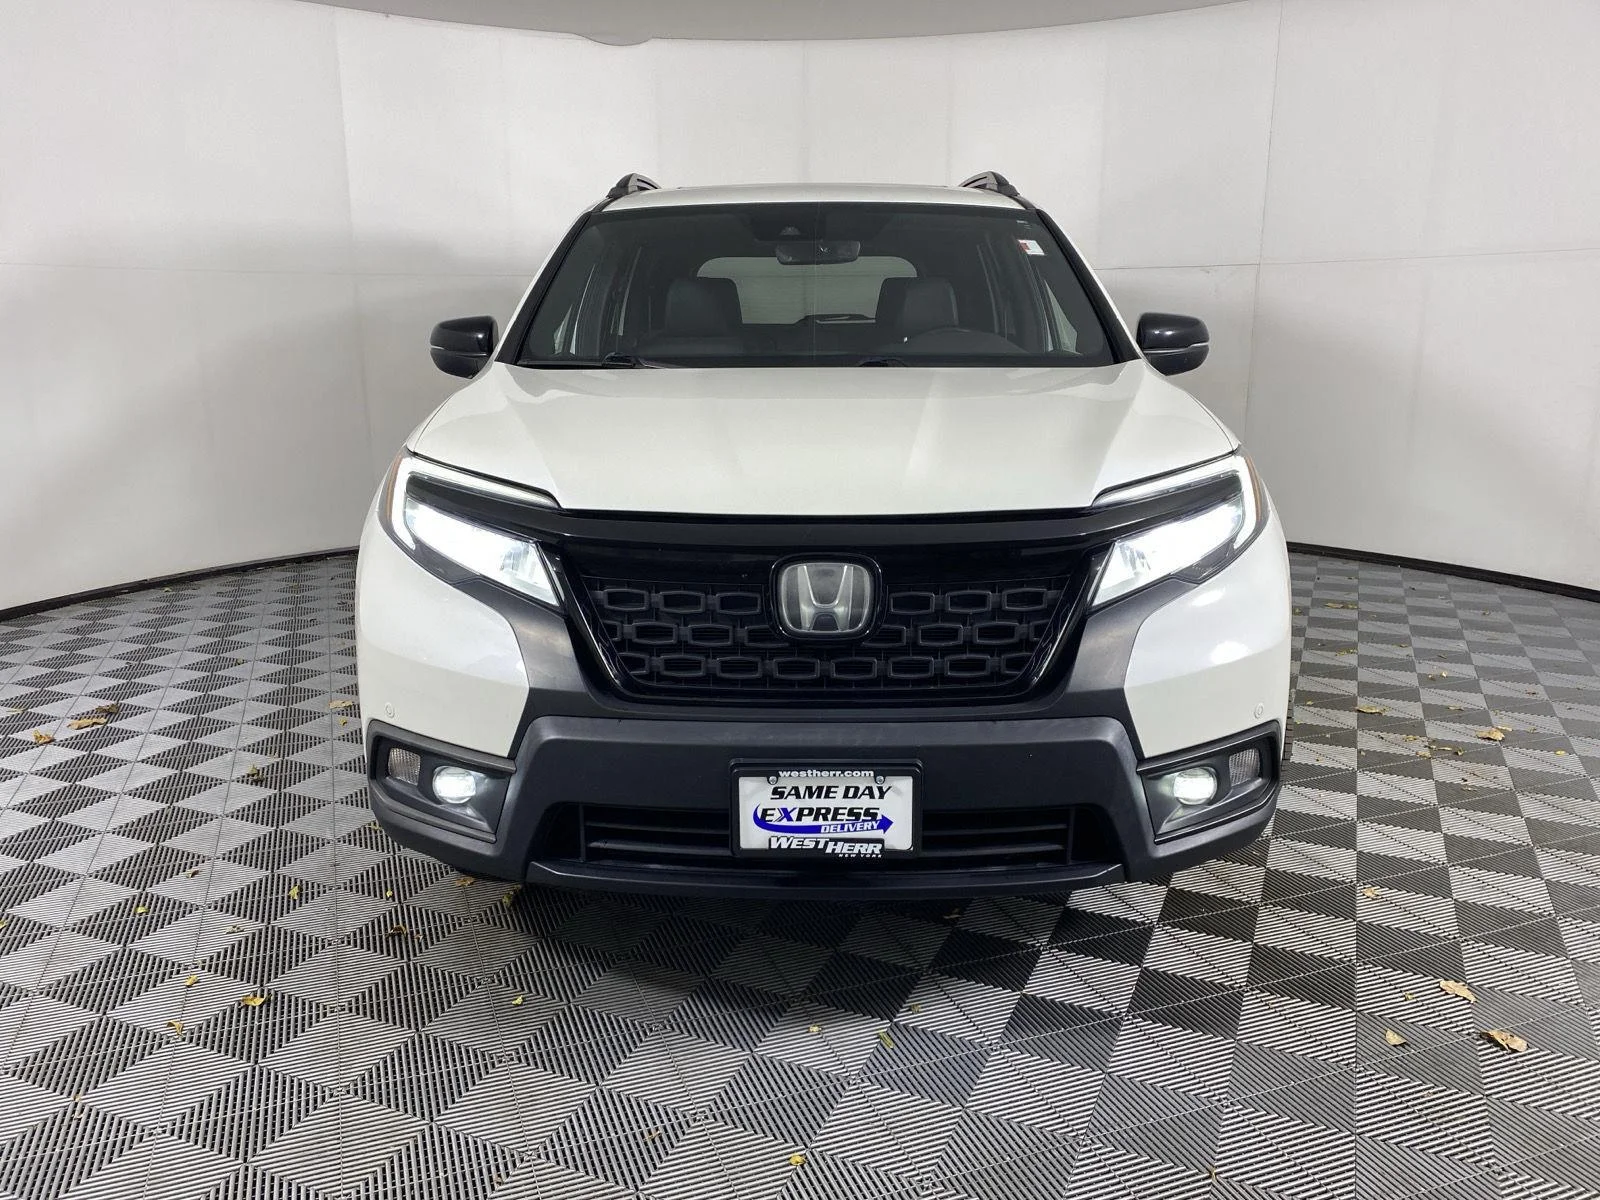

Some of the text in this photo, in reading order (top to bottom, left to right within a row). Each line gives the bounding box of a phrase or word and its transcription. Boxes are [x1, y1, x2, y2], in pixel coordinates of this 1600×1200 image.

[778, 769, 874, 777] westherr.com
[770, 785, 892, 800] SAME DAY
[759, 807, 880, 822] EXPRESS
[820, 821, 881, 833] DELIVERY
